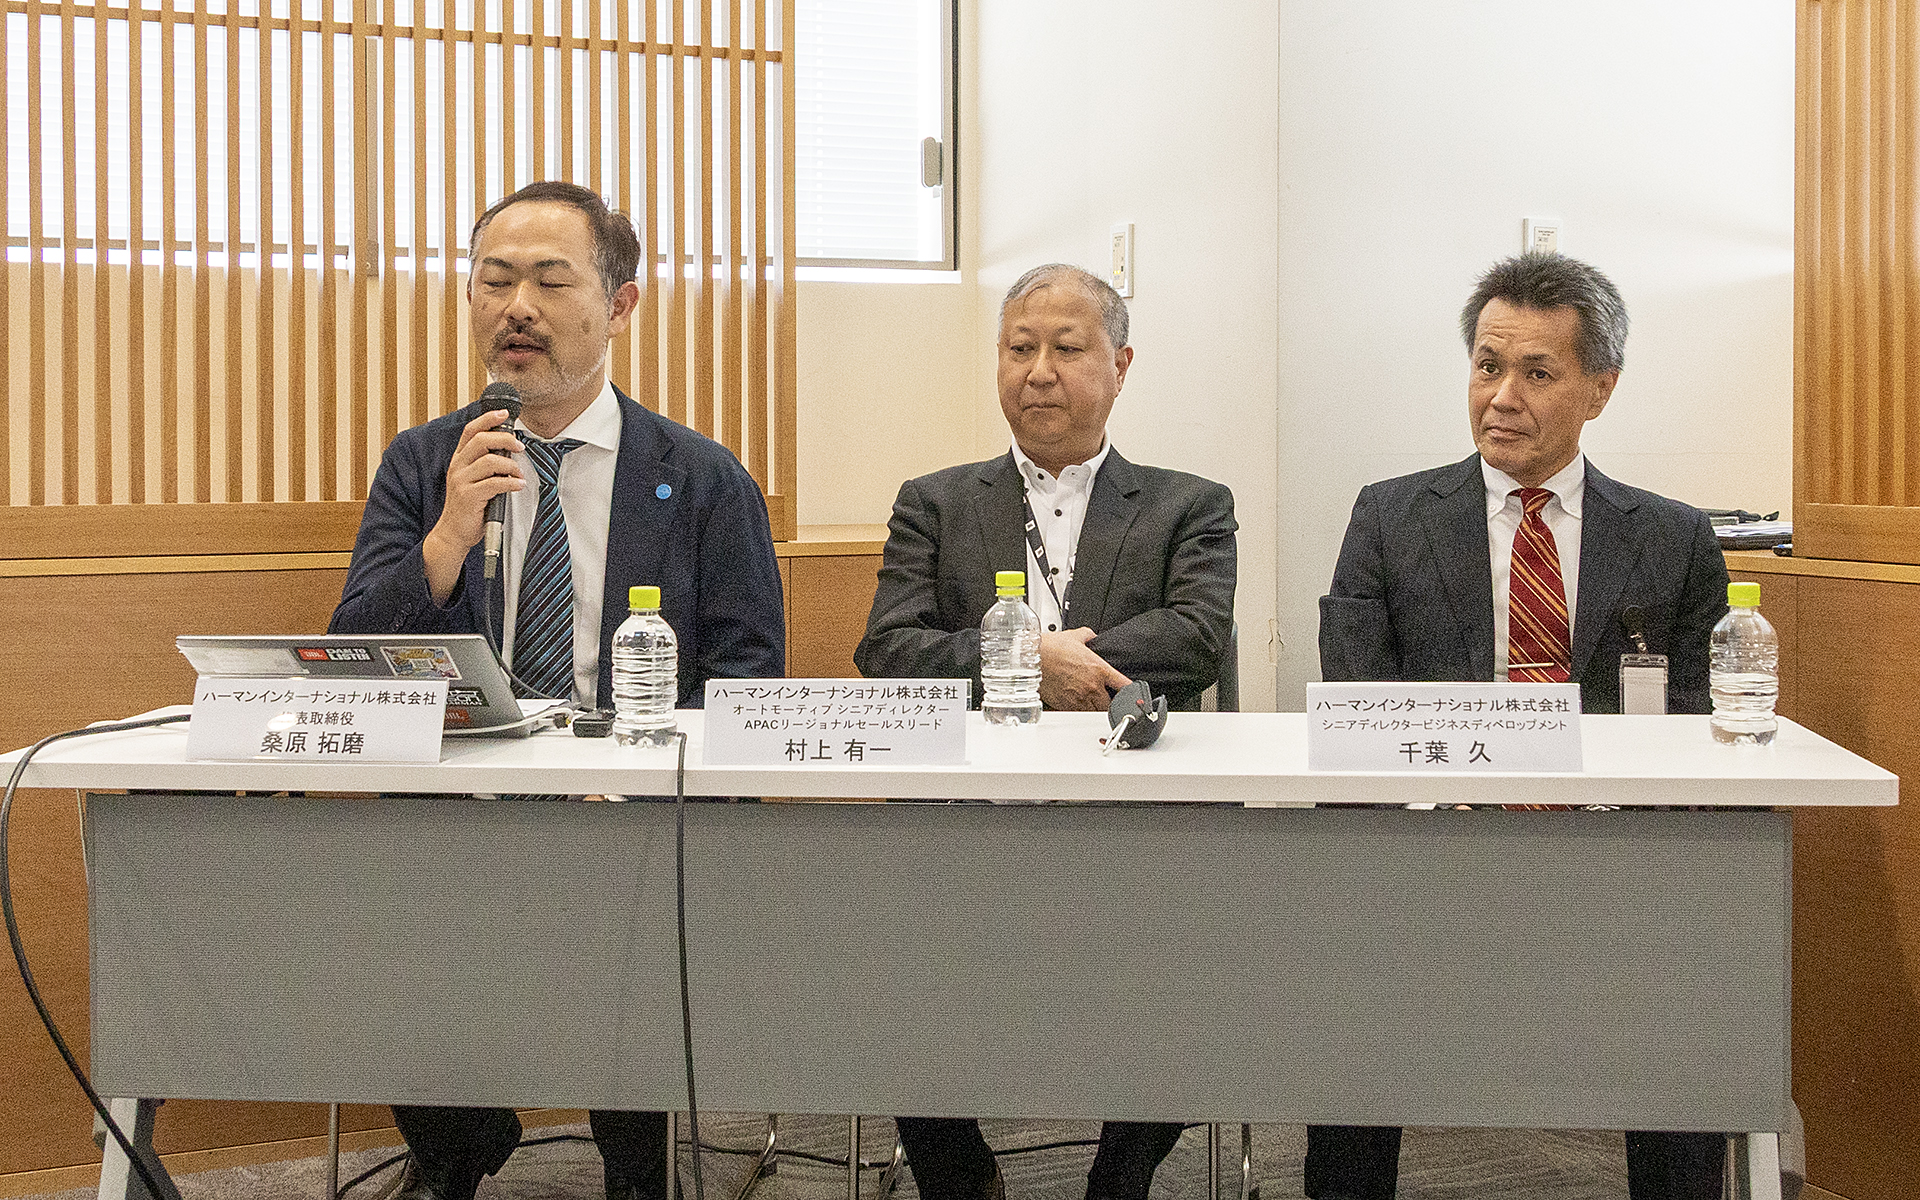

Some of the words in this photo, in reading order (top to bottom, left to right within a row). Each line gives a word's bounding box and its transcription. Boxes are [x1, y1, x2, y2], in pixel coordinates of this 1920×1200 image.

[202, 690, 438, 706] ハーマンインターナショナル株式会社
[714, 685, 958, 700] ハーマンインターナショナル株式会社
[838, 703, 950, 715] シニアディレクター
[1316, 698, 1570, 713] ハーマンインターナショナル株式会社
[281, 711, 355, 726] 表取締役
[744, 718, 943, 731] APACリージョナルセールスリード
[260, 731, 308, 754] 桑原
[317, 731, 365, 755] 拓磨
[785, 738, 833, 762] 村上
[844, 738, 891, 762] 有一
[1399, 740, 1450, 764] 千葉
[1468, 740, 1492, 764] 久
